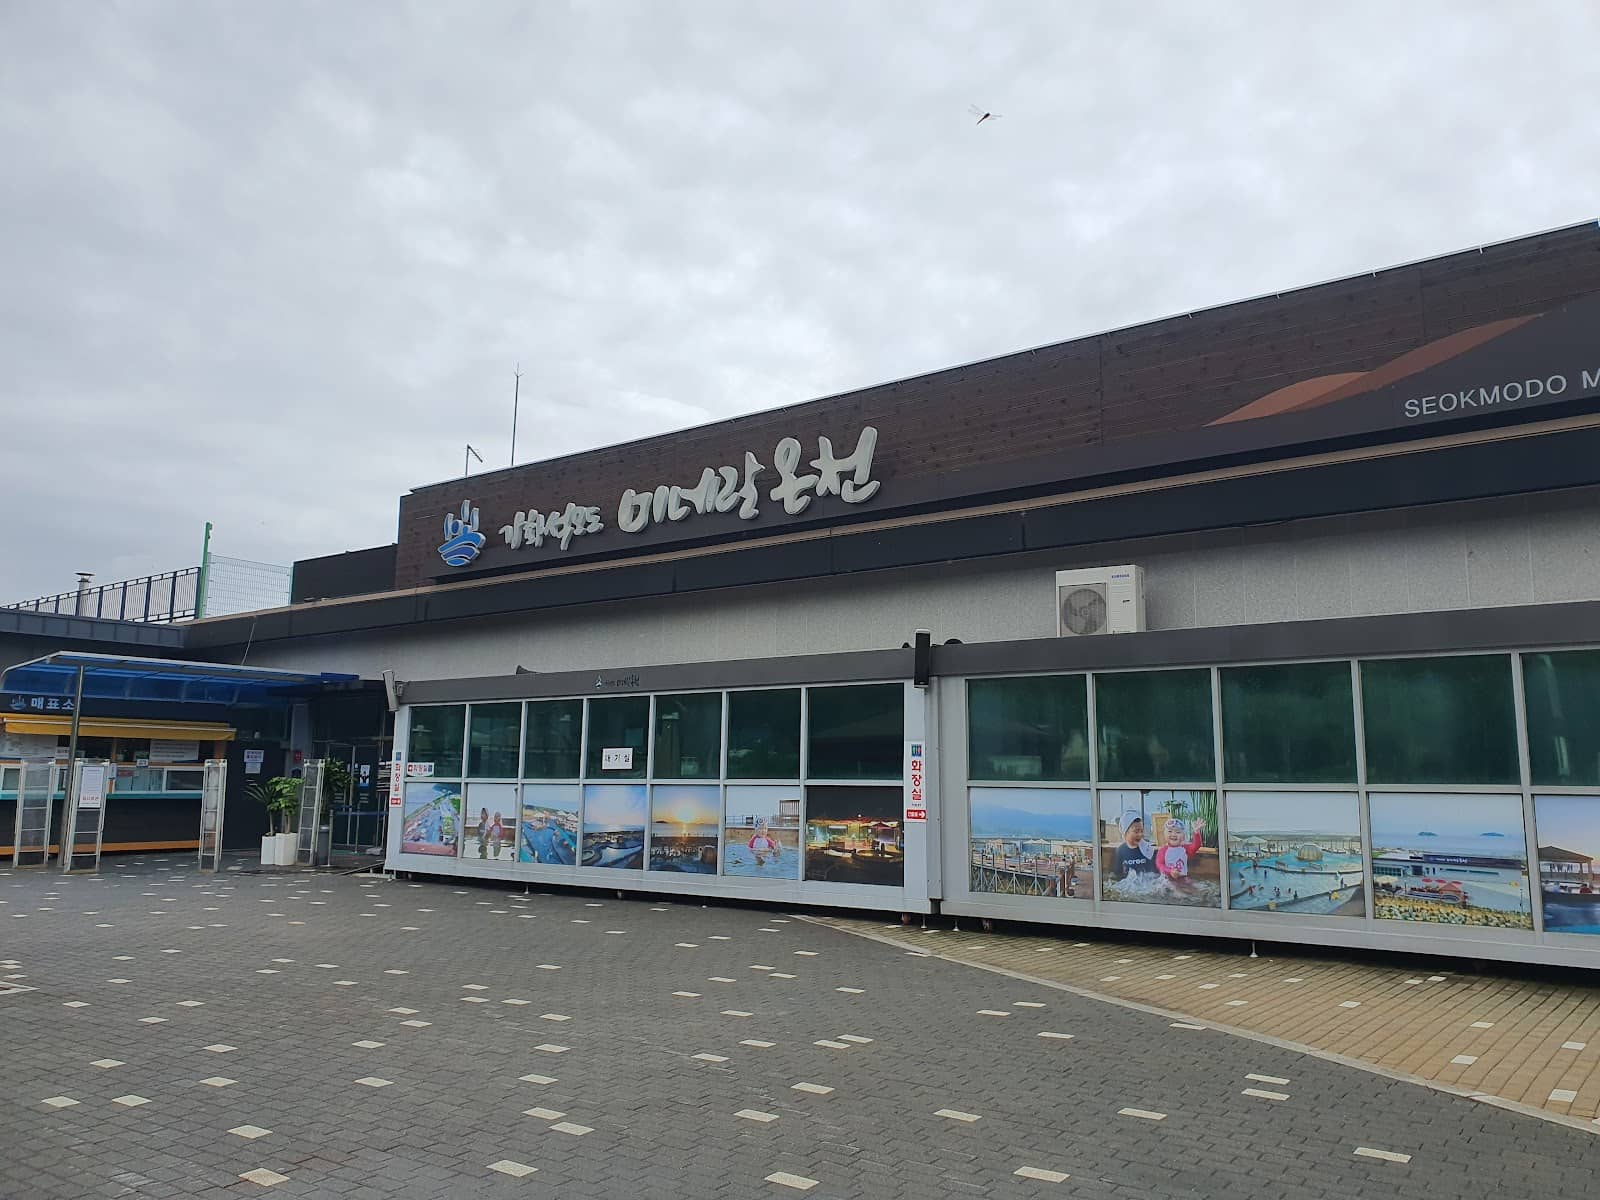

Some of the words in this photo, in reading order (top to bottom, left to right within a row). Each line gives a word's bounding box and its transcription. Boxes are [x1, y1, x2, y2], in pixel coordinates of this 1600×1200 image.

[1404, 374, 1568, 418] SEOKMODO
[770, 426, 881, 515] 온천
[30, 697, 75, 711] 매표소
[911, 759, 923, 801] 화장실
